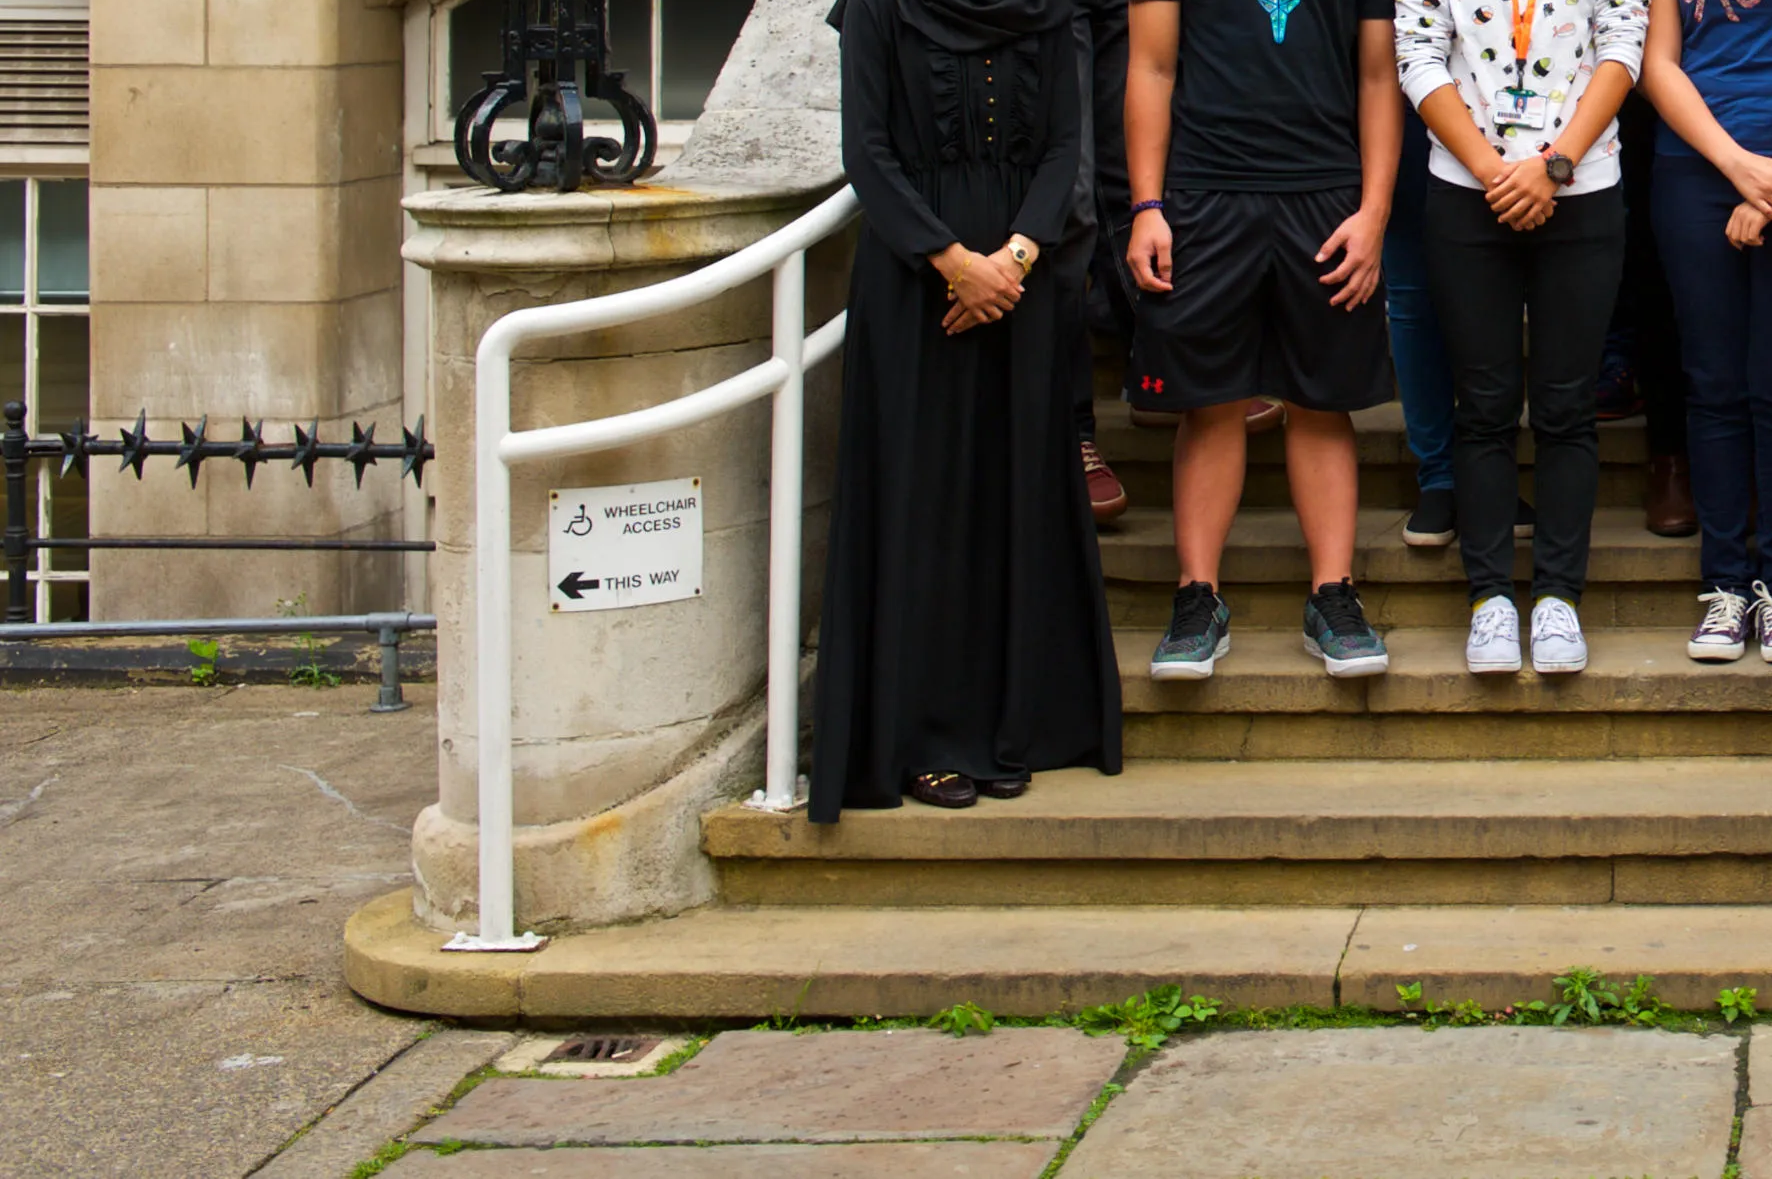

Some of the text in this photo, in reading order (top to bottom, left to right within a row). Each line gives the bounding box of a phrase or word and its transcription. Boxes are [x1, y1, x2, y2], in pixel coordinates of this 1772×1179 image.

[604, 497, 697, 518] WHEELCHAIR
[622, 516, 681, 535] ACCESS
[605, 569, 680, 591] THIS WAY
